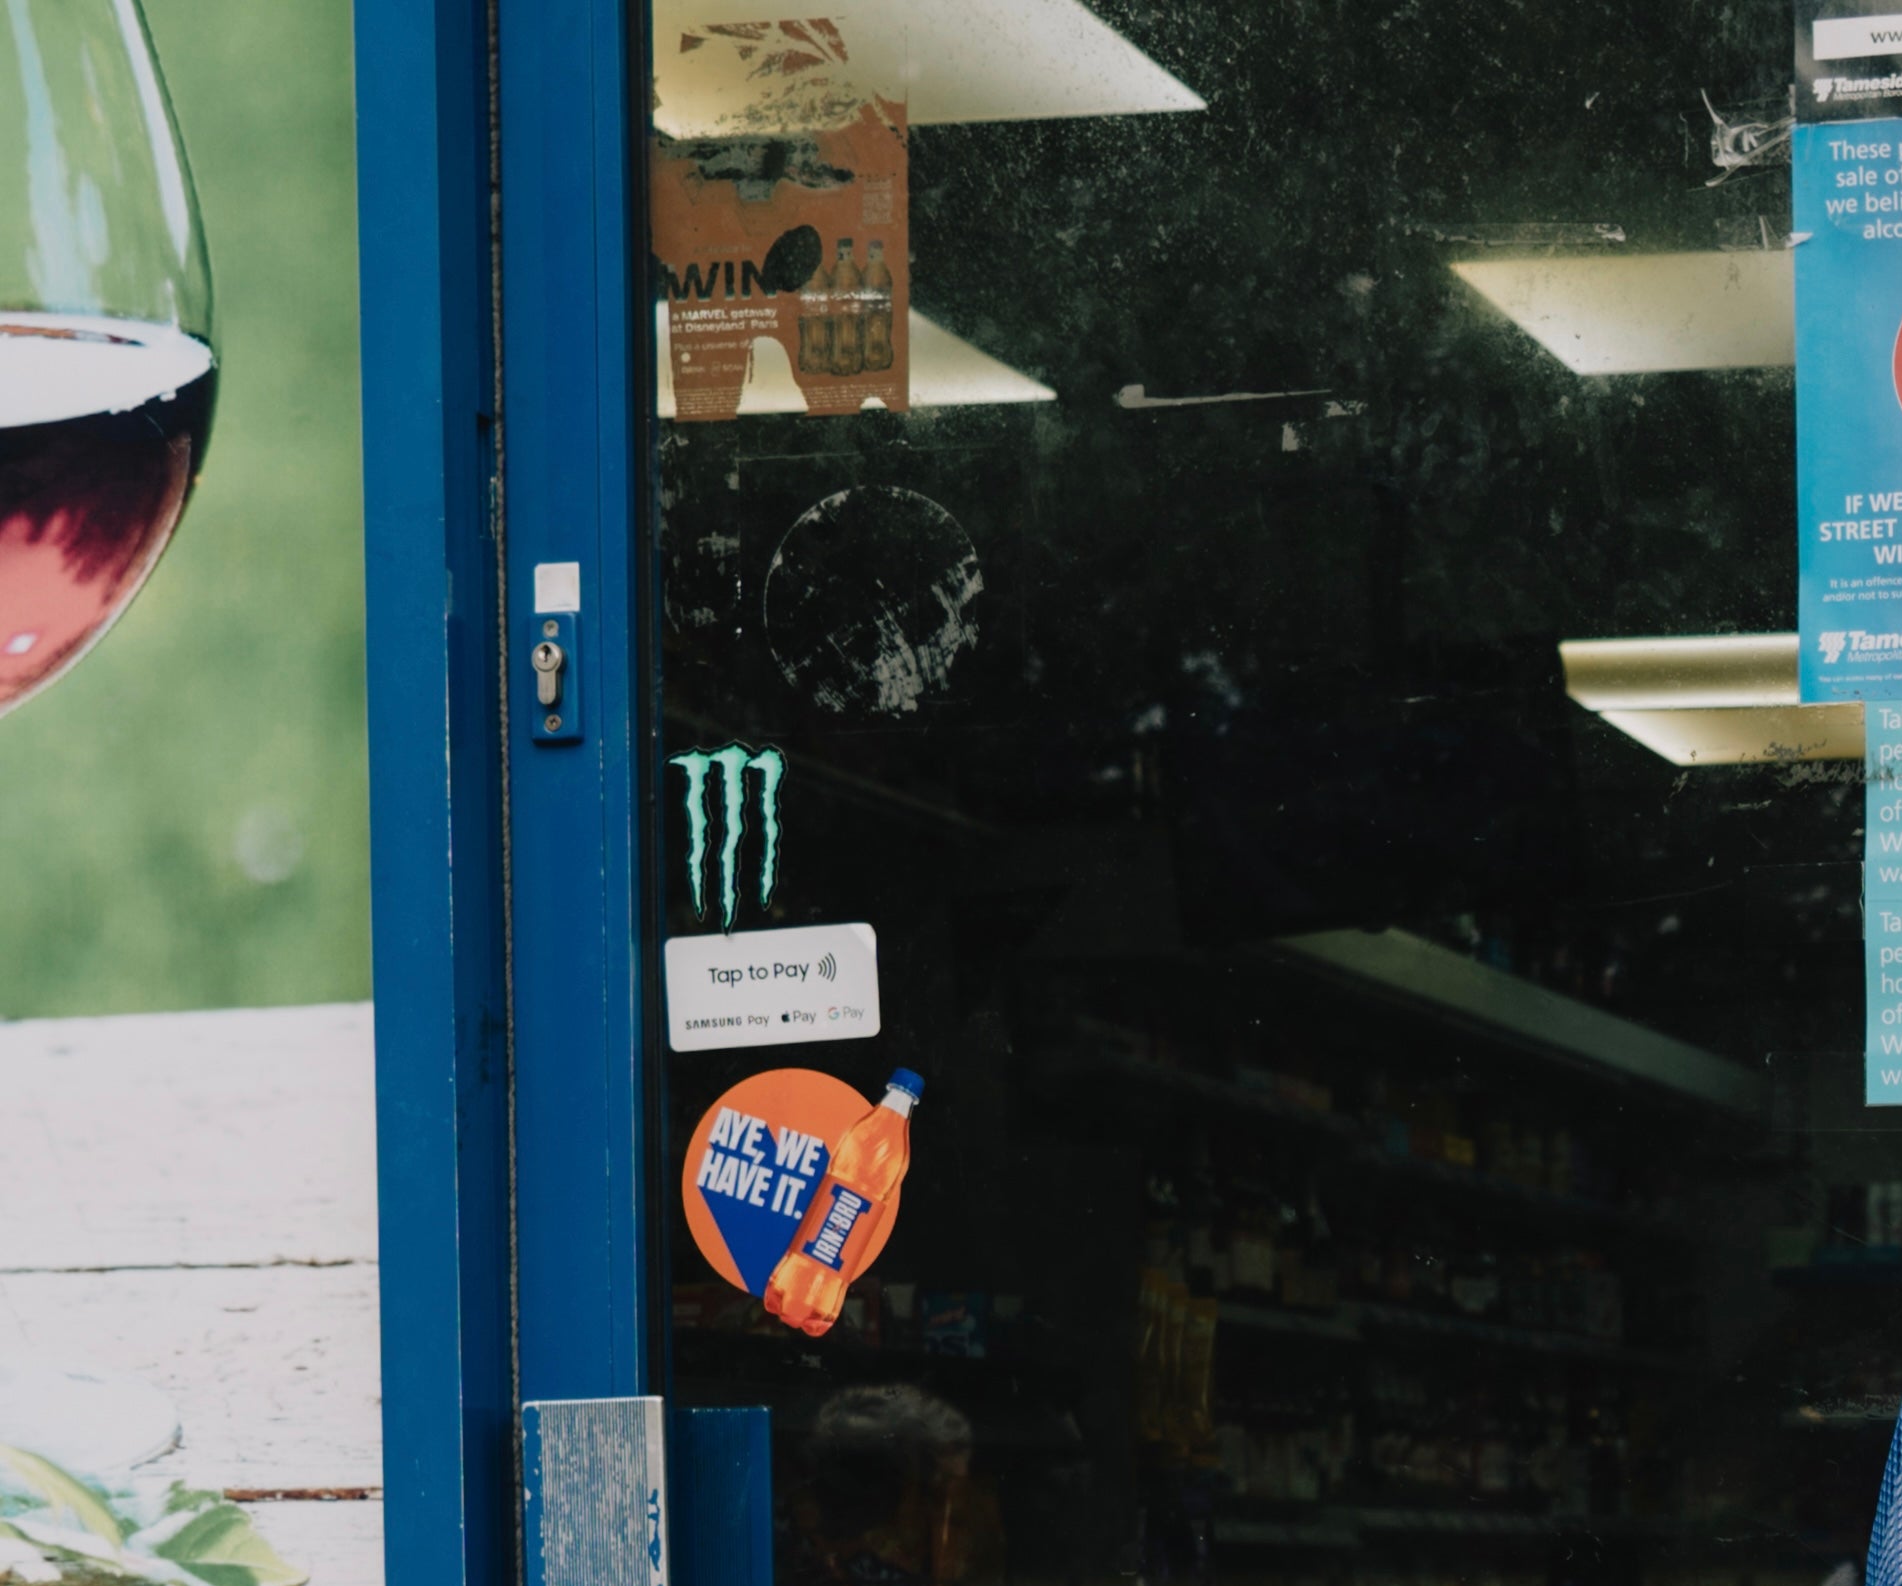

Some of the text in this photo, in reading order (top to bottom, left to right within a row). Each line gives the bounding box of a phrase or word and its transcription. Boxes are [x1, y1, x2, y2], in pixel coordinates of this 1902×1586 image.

[1829, 140, 1891, 161] These
[1836, 165, 1877, 188] sale
[1826, 196, 1857, 215] we
[682, 309, 727, 321] MARVEL
[730, 308, 777, 321] getaway
[672, 319, 779, 334] at Disneyland Paris
[1845, 496, 1863, 515] IF
[1819, 518, 1897, 543] STREET
[1840, 579, 1848, 588] is
[1851, 580, 1863, 588] an
[1866, 576, 1902, 588] offence
[1858, 591, 1876, 600] not
[1878, 590, 1889, 599] to
[708, 962, 809, 988] Tap to Pay
[685, 1014, 770, 1030] SAMSUNG Pay
[793, 1010, 816, 1024] Pay
[843, 1006, 865, 1020] Pay
[709, 1106, 824, 1176] AYE, WE
[696, 1148, 806, 1220] HAVE IT.
